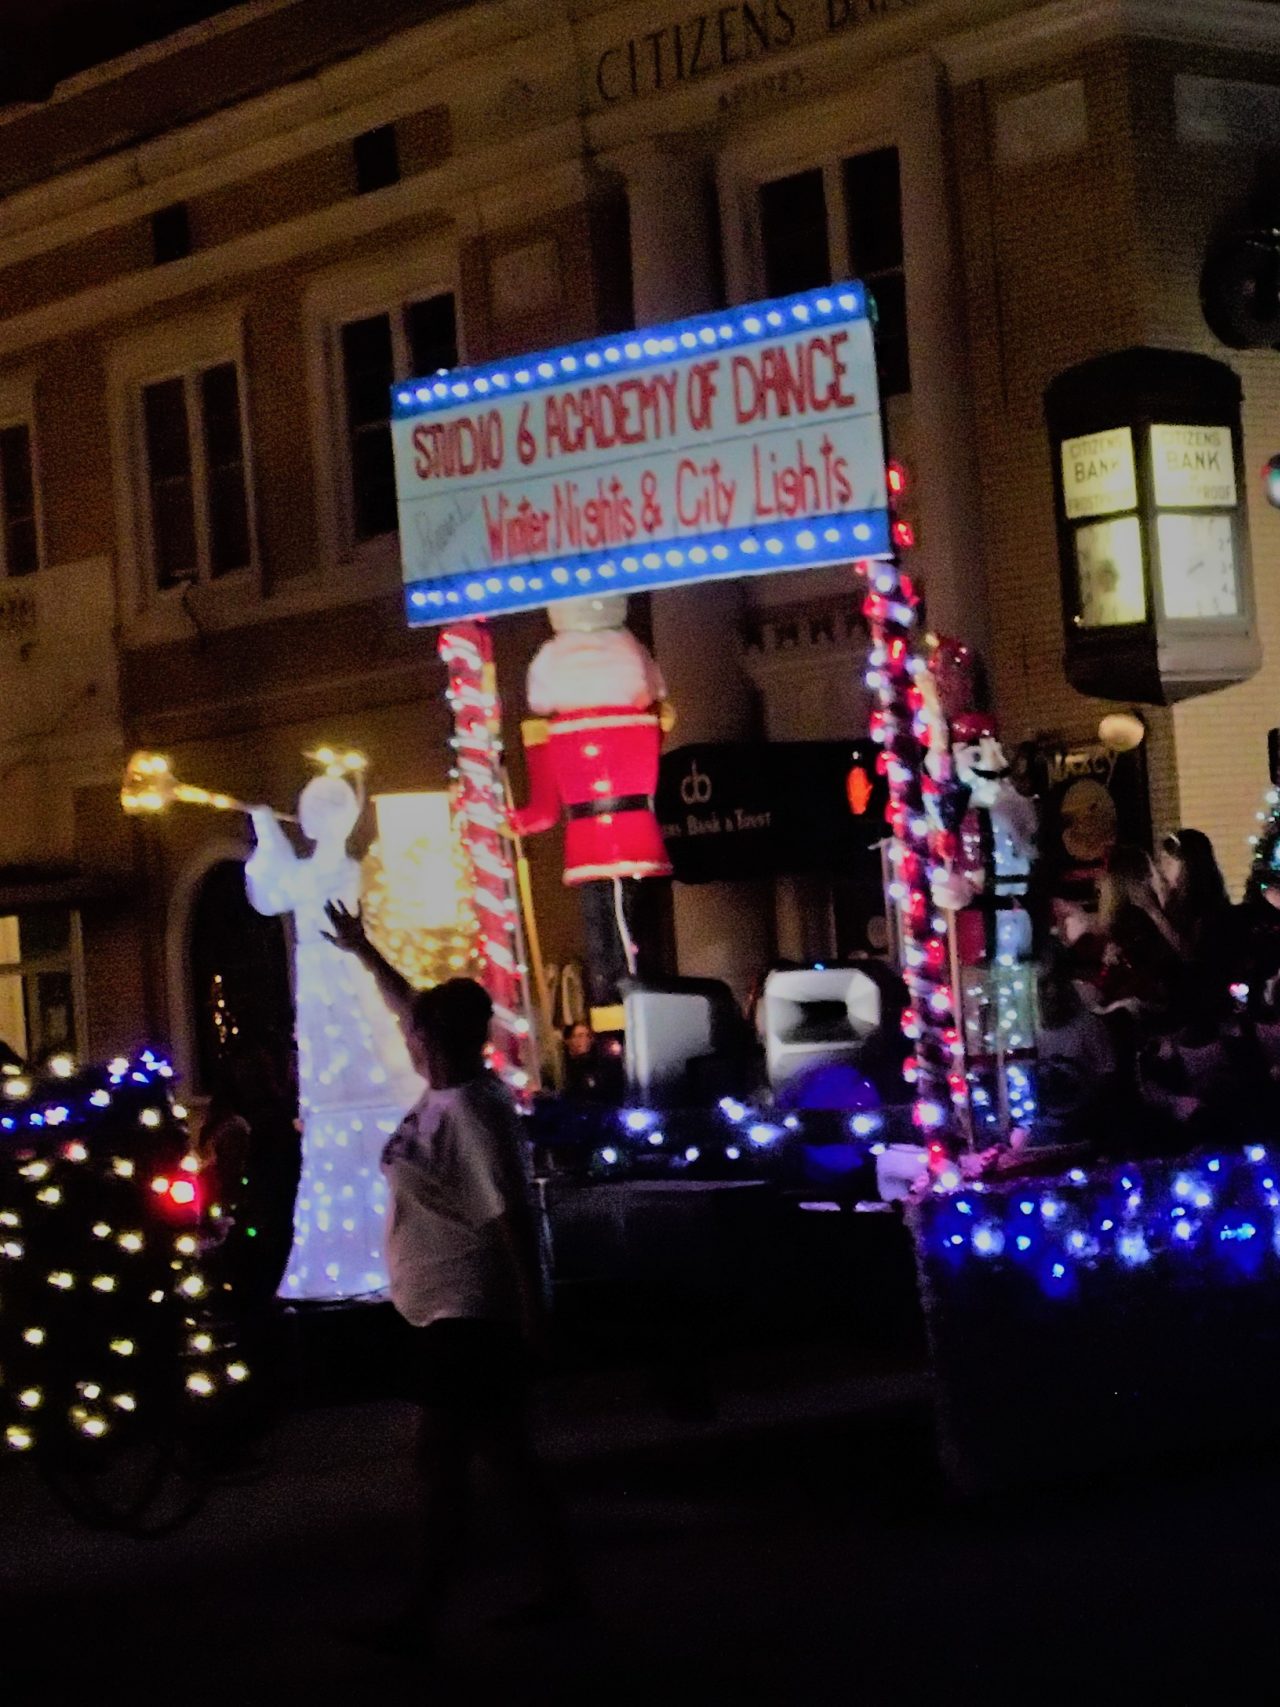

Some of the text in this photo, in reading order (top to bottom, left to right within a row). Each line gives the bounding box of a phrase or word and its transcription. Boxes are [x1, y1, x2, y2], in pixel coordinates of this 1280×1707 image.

[594, 0, 796, 104] CITIZENS
[412, 330, 857, 480] STUDIO 6 ACADEMY OF DANCE
[1166, 448, 1222, 473] BANK
[480, 491, 552, 562] Winter
[554, 474, 636, 549] Nights
[640, 470, 664, 534] &
[675, 457, 738, 526] City
[751, 433, 855, 517] Lights
